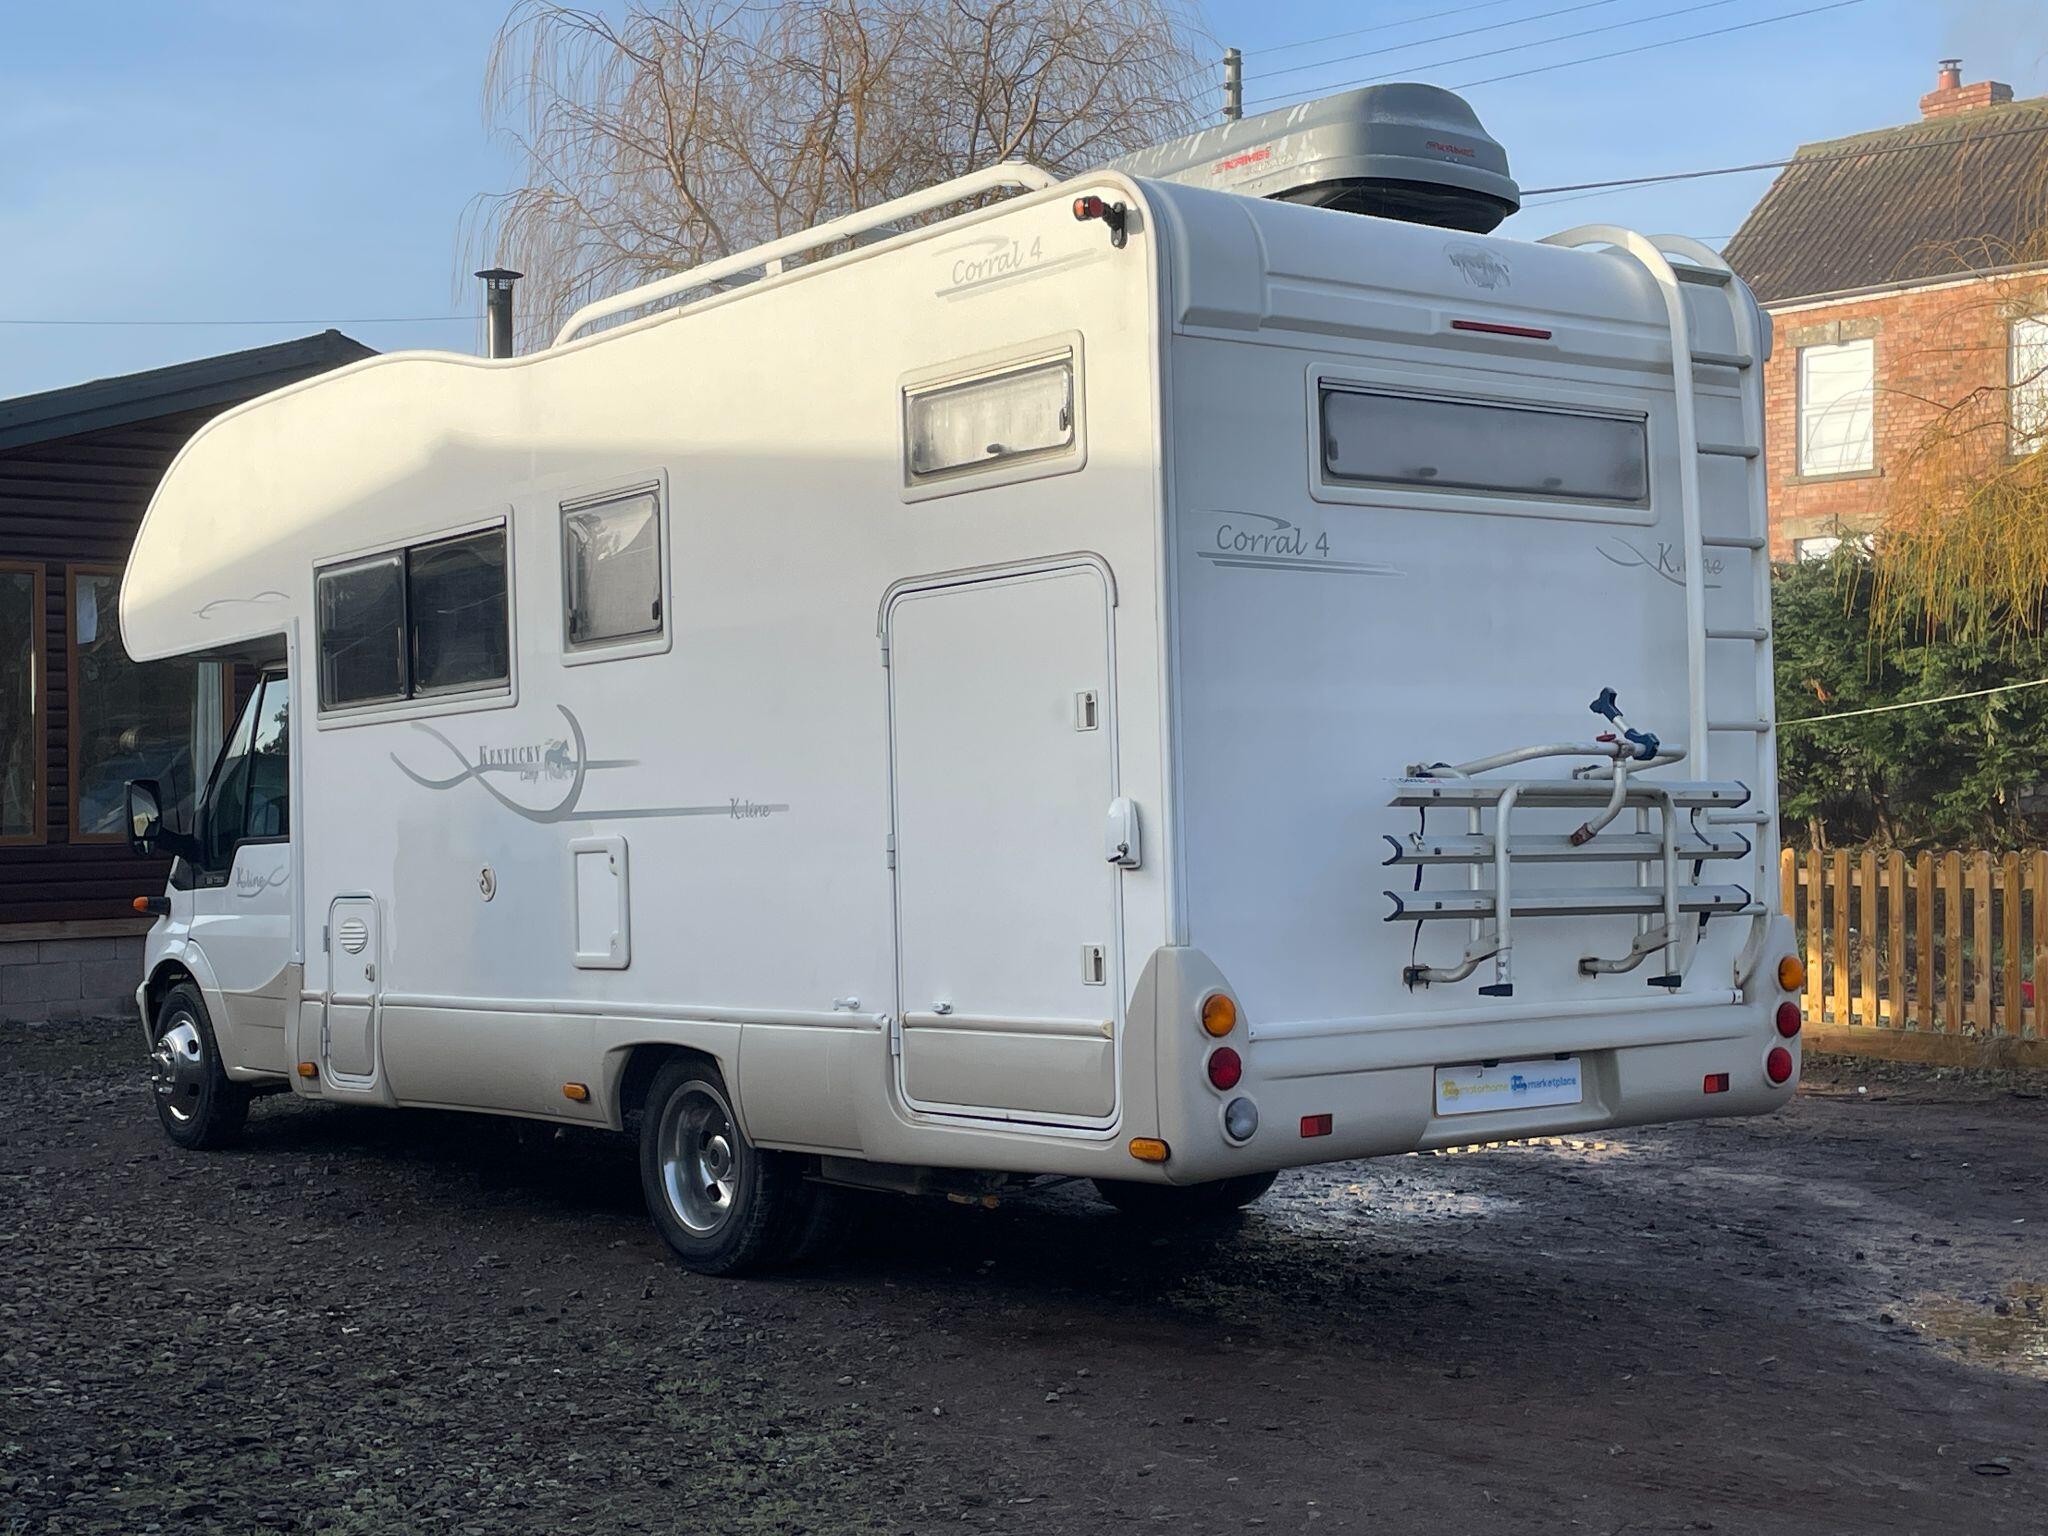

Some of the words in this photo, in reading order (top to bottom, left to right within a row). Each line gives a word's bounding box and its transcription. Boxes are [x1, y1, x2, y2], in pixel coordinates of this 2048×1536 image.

[952, 240, 1024, 284] Corral
[1030, 235, 1042, 261] 4
[1216, 524, 1308, 556] Corral
[1315, 531, 1330, 558] 4
[479, 744, 541, 766] KENTUCKY
[1527, 1076, 1577, 1090] marketplace
